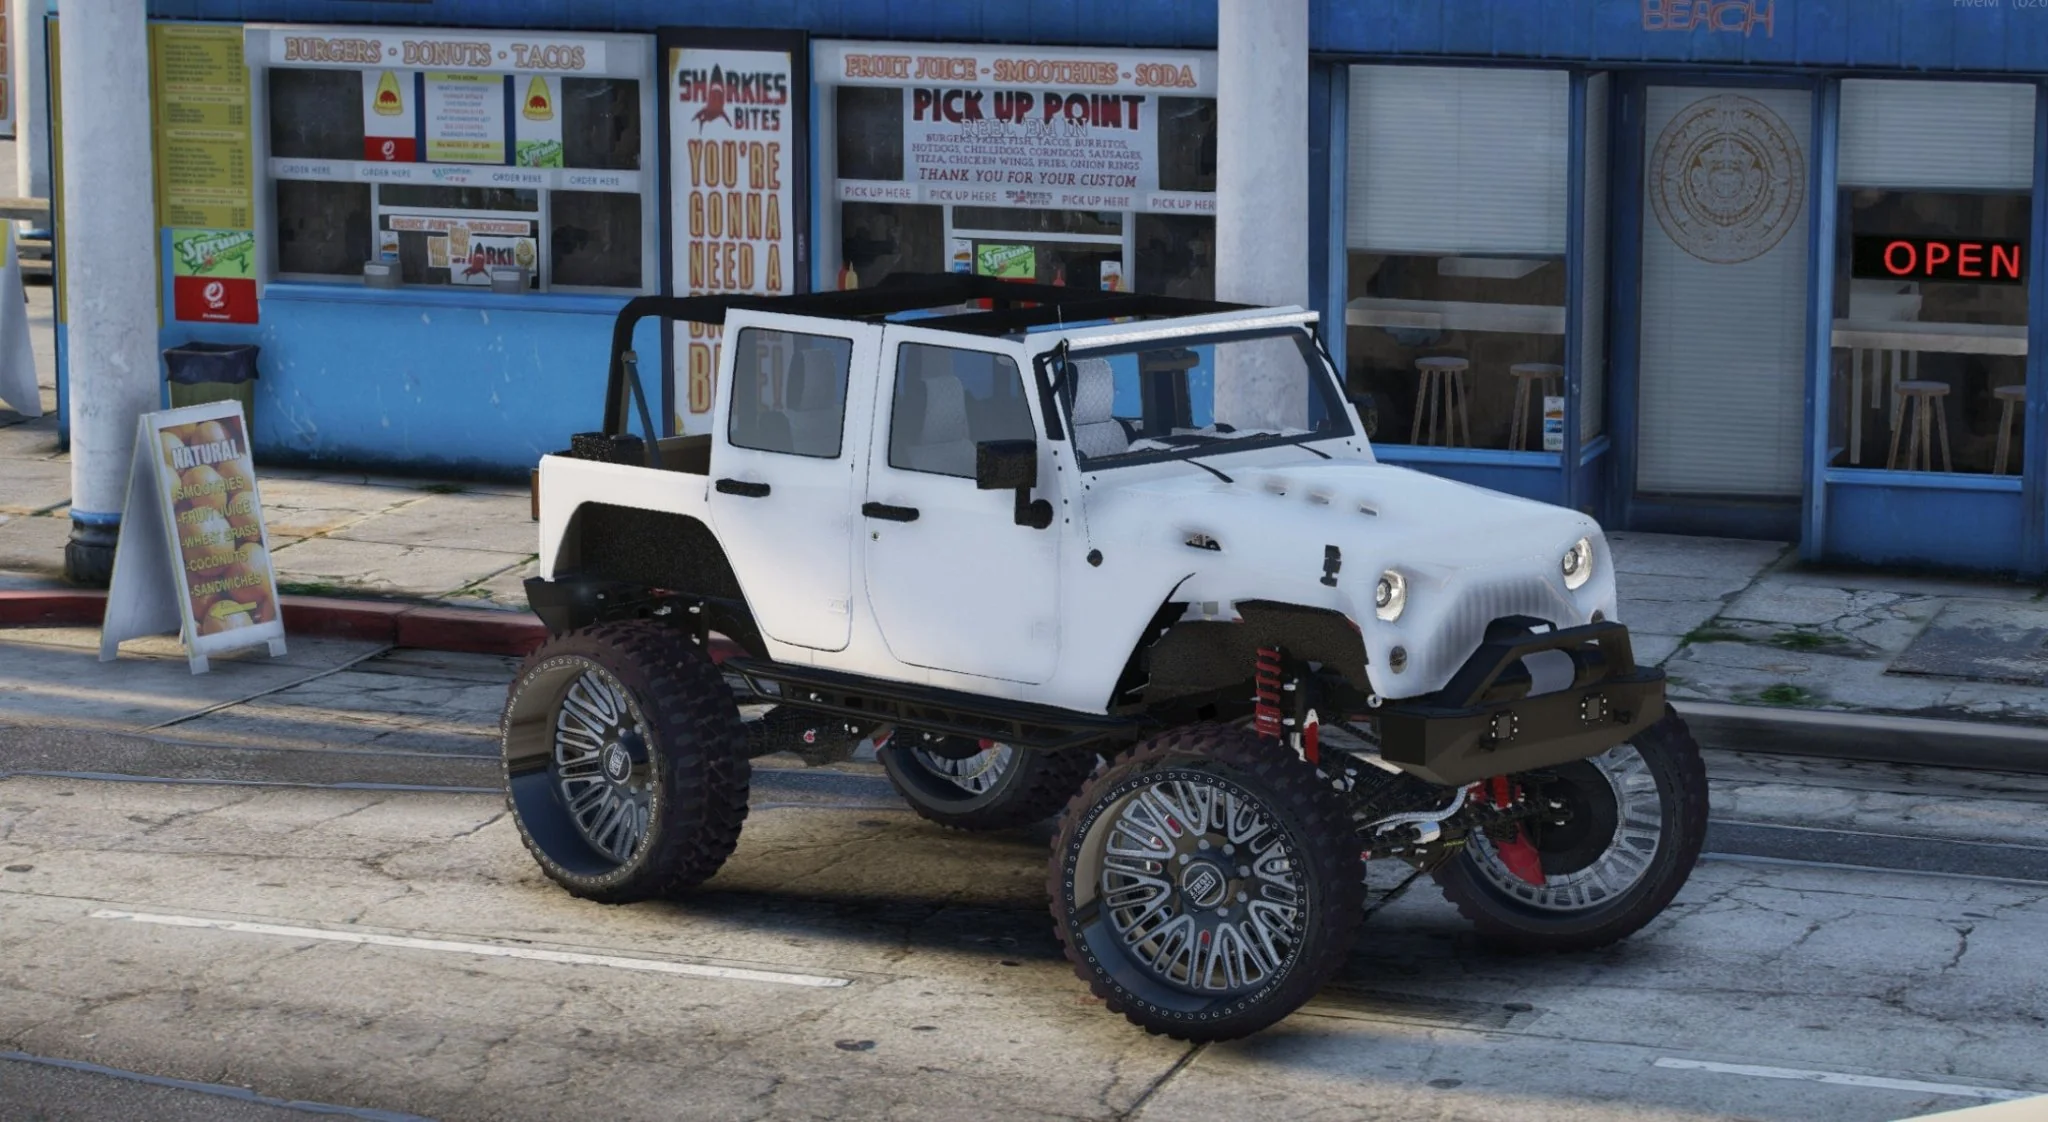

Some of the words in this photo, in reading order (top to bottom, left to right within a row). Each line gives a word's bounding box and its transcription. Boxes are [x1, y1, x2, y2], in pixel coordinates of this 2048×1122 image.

[1641, 0, 1775, 38] BEACH
[285, 37, 382, 63] BURGERS
[402, 40, 492, 67] DONUTS
[511, 43, 586, 70] TACOS
[845, 54, 911, 79] FRUIT
[914, 56, 977, 81] JUICE
[993, 58, 1119, 85] SMOOTHIES
[1135, 63, 1197, 88] SODA
[678, 64, 788, 106] SHARKIES
[734, 107, 781, 131] BITES
[912, 88, 984, 124] PICK
[994, 90, 1035, 125] UP
[1043, 92, 1146, 130] POINT
[960, 118, 1017, 137] REEL
[1063, 118, 1089, 138] IN
[282, 164, 309, 175] ORDER
[311, 165, 331, 176] HERE
[362, 168, 389, 177] ORDER
[391, 168, 411, 178] HERE
[688, 139, 781, 190] YOU'RE
[948, 154, 997, 165] CHICKEN
[1070, 158, 1105, 169] ONION
[1107, 160, 1140, 171] RINGS
[492, 172, 520, 182] ORDER
[522, 173, 543, 183] HERE
[569, 175, 597, 185] ORDER
[599, 176, 620, 186] HERE
[919, 167, 970, 182] THANK
[976, 169, 1004, 183] YOU
[1007, 170, 1033, 184] FOR
[1039, 171, 1077, 186] YOUR
[1080, 173, 1138, 188] CUSTOM
[844, 186, 868, 197] PICK
[870, 187, 883, 197] UP
[886, 187, 911, 199] HERE
[930, 189, 952, 200] PICK
[955, 190, 969, 201] UP
[971, 191, 997, 202] HERE
[1062, 194, 1085, 205] PICK
[1087, 195, 1101, 206] UP
[1104, 196, 1130, 207] HERE
[1152, 197, 1175, 209] PICK
[1178, 199, 1192, 209] UP
[1194, 199, 1216, 211] HER
[689, 191, 782, 241] GONNA
[689, 240, 755, 289] NEED
[766, 244, 783, 291] A
[1884, 240, 2021, 278] OPEN
[171, 438, 241, 470] NATURAL
